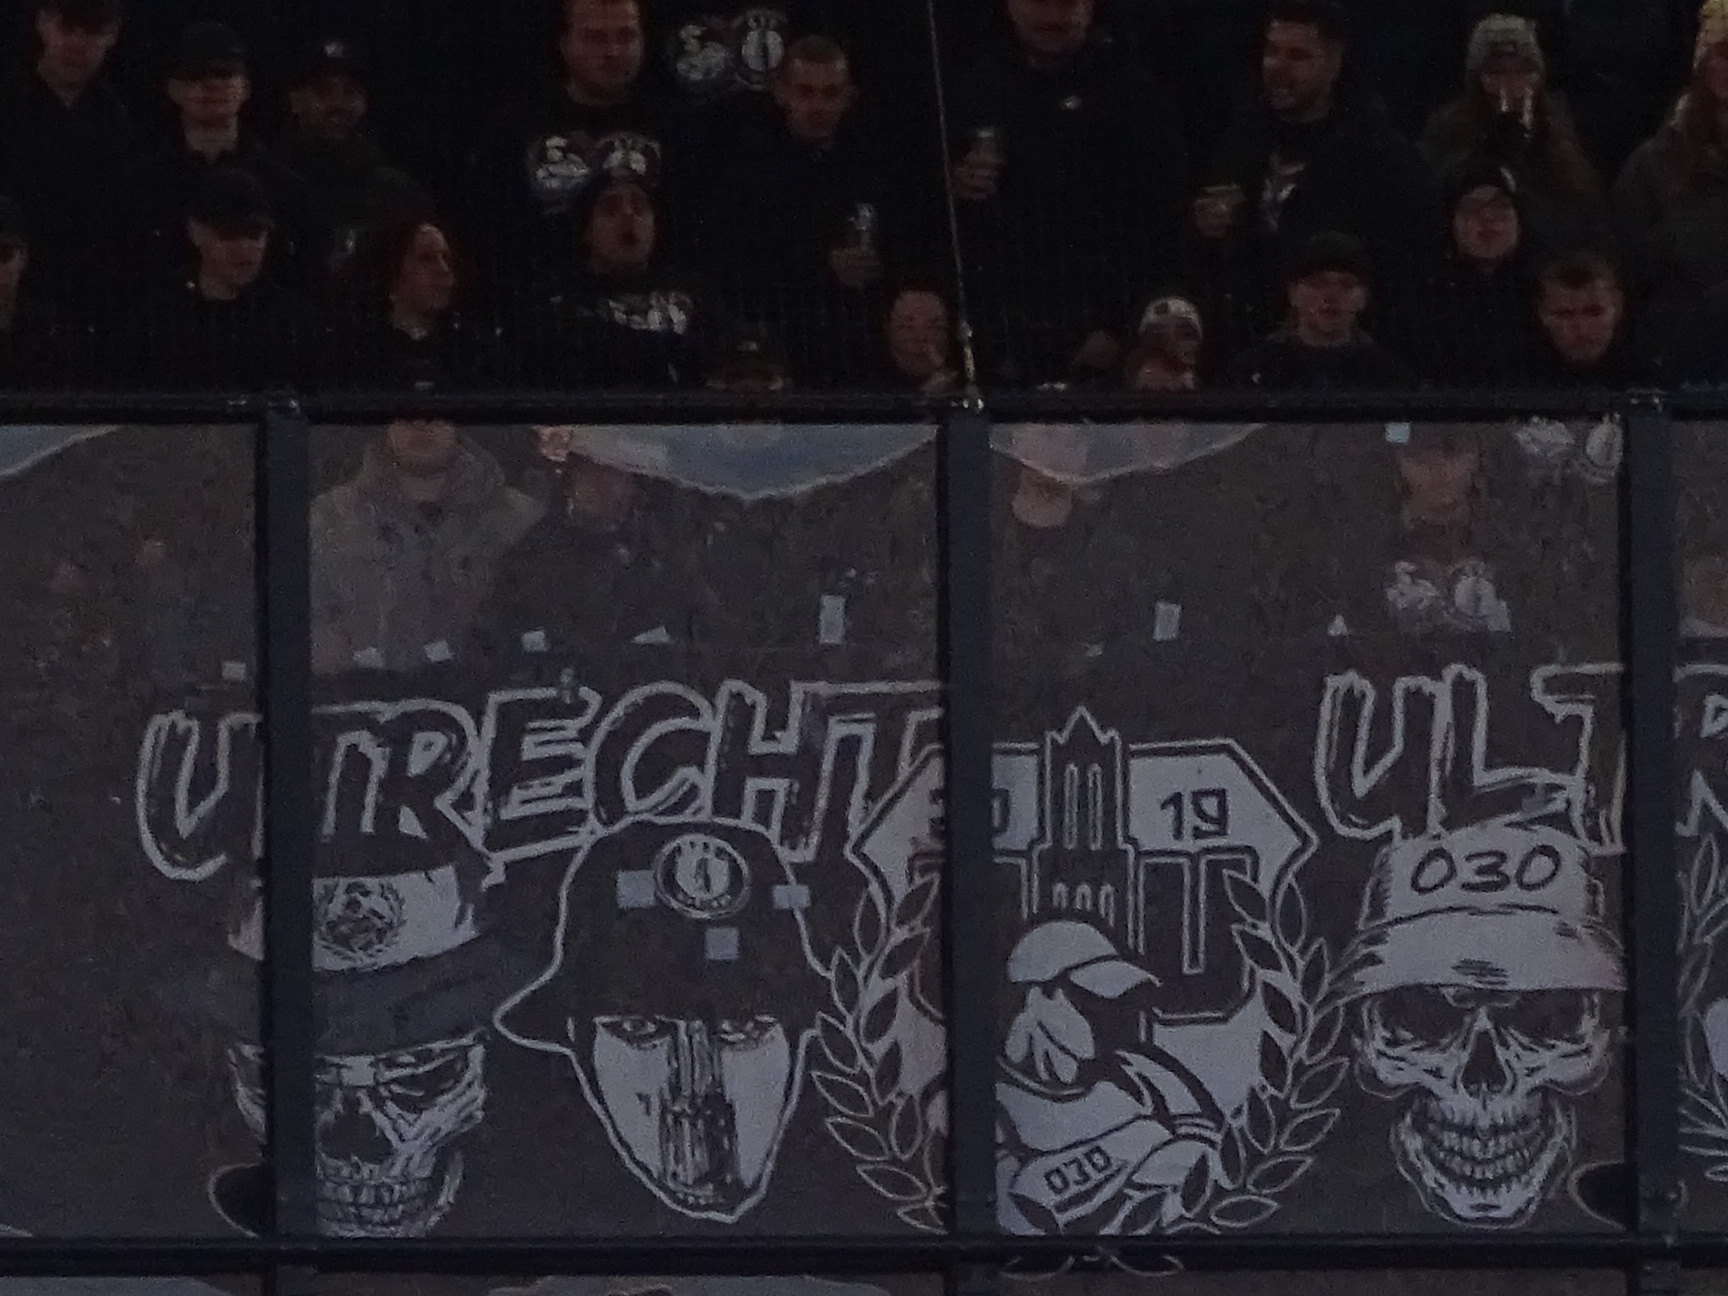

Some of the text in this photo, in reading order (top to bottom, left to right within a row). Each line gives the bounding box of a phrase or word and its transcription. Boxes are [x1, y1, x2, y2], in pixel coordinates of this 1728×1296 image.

[1159, 788, 1229, 840] 19
[1410, 846, 1562, 896] 030
[1044, 1145, 1112, 1195] 030
